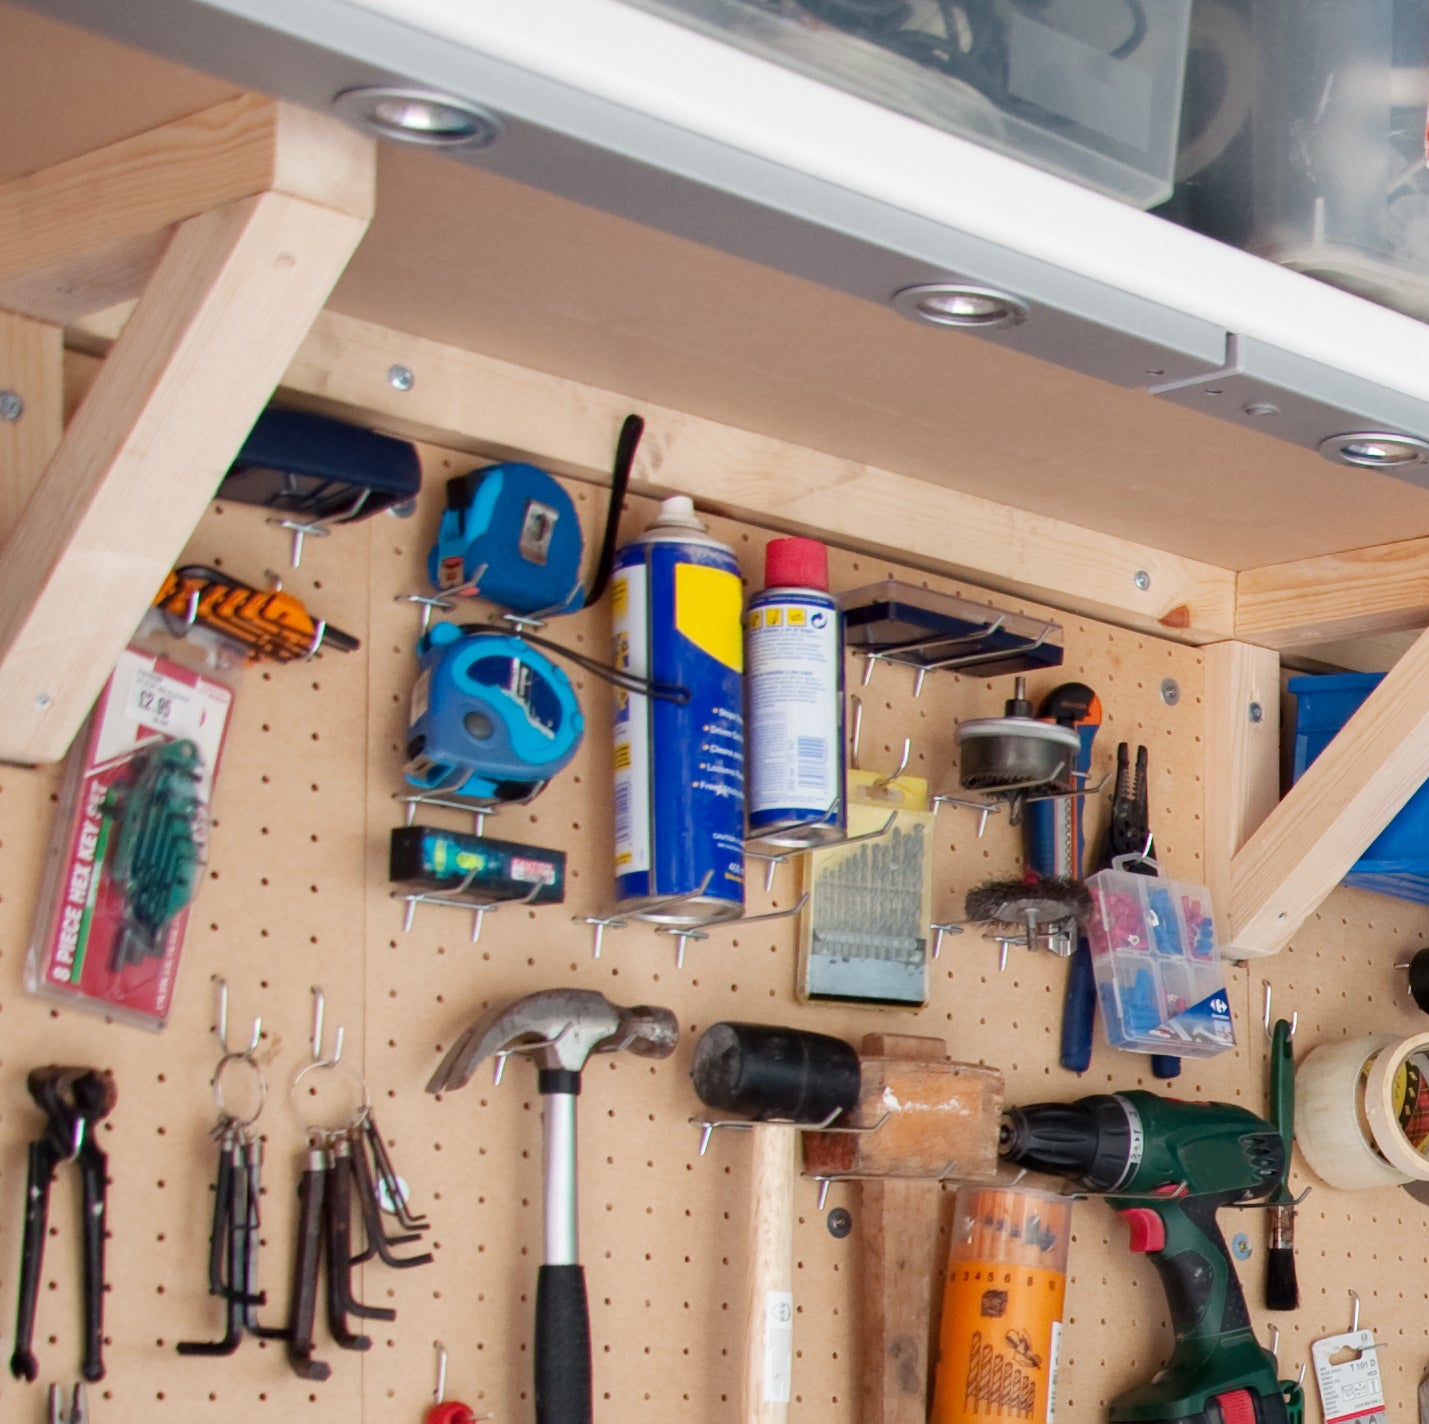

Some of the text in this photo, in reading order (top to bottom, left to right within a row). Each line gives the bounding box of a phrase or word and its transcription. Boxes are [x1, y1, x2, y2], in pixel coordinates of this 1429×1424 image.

[77, 819, 100, 861] KEY
[68, 861, 93, 903] HEX
[55, 905, 83, 965] PIECE
[51, 966, 72, 983] 8
[963, 1271, 970, 1281] 3
[975, 1271, 981, 1280] 4
[987, 1272, 994, 1282] 5
[1004, 1273, 1011, 1283] 6
